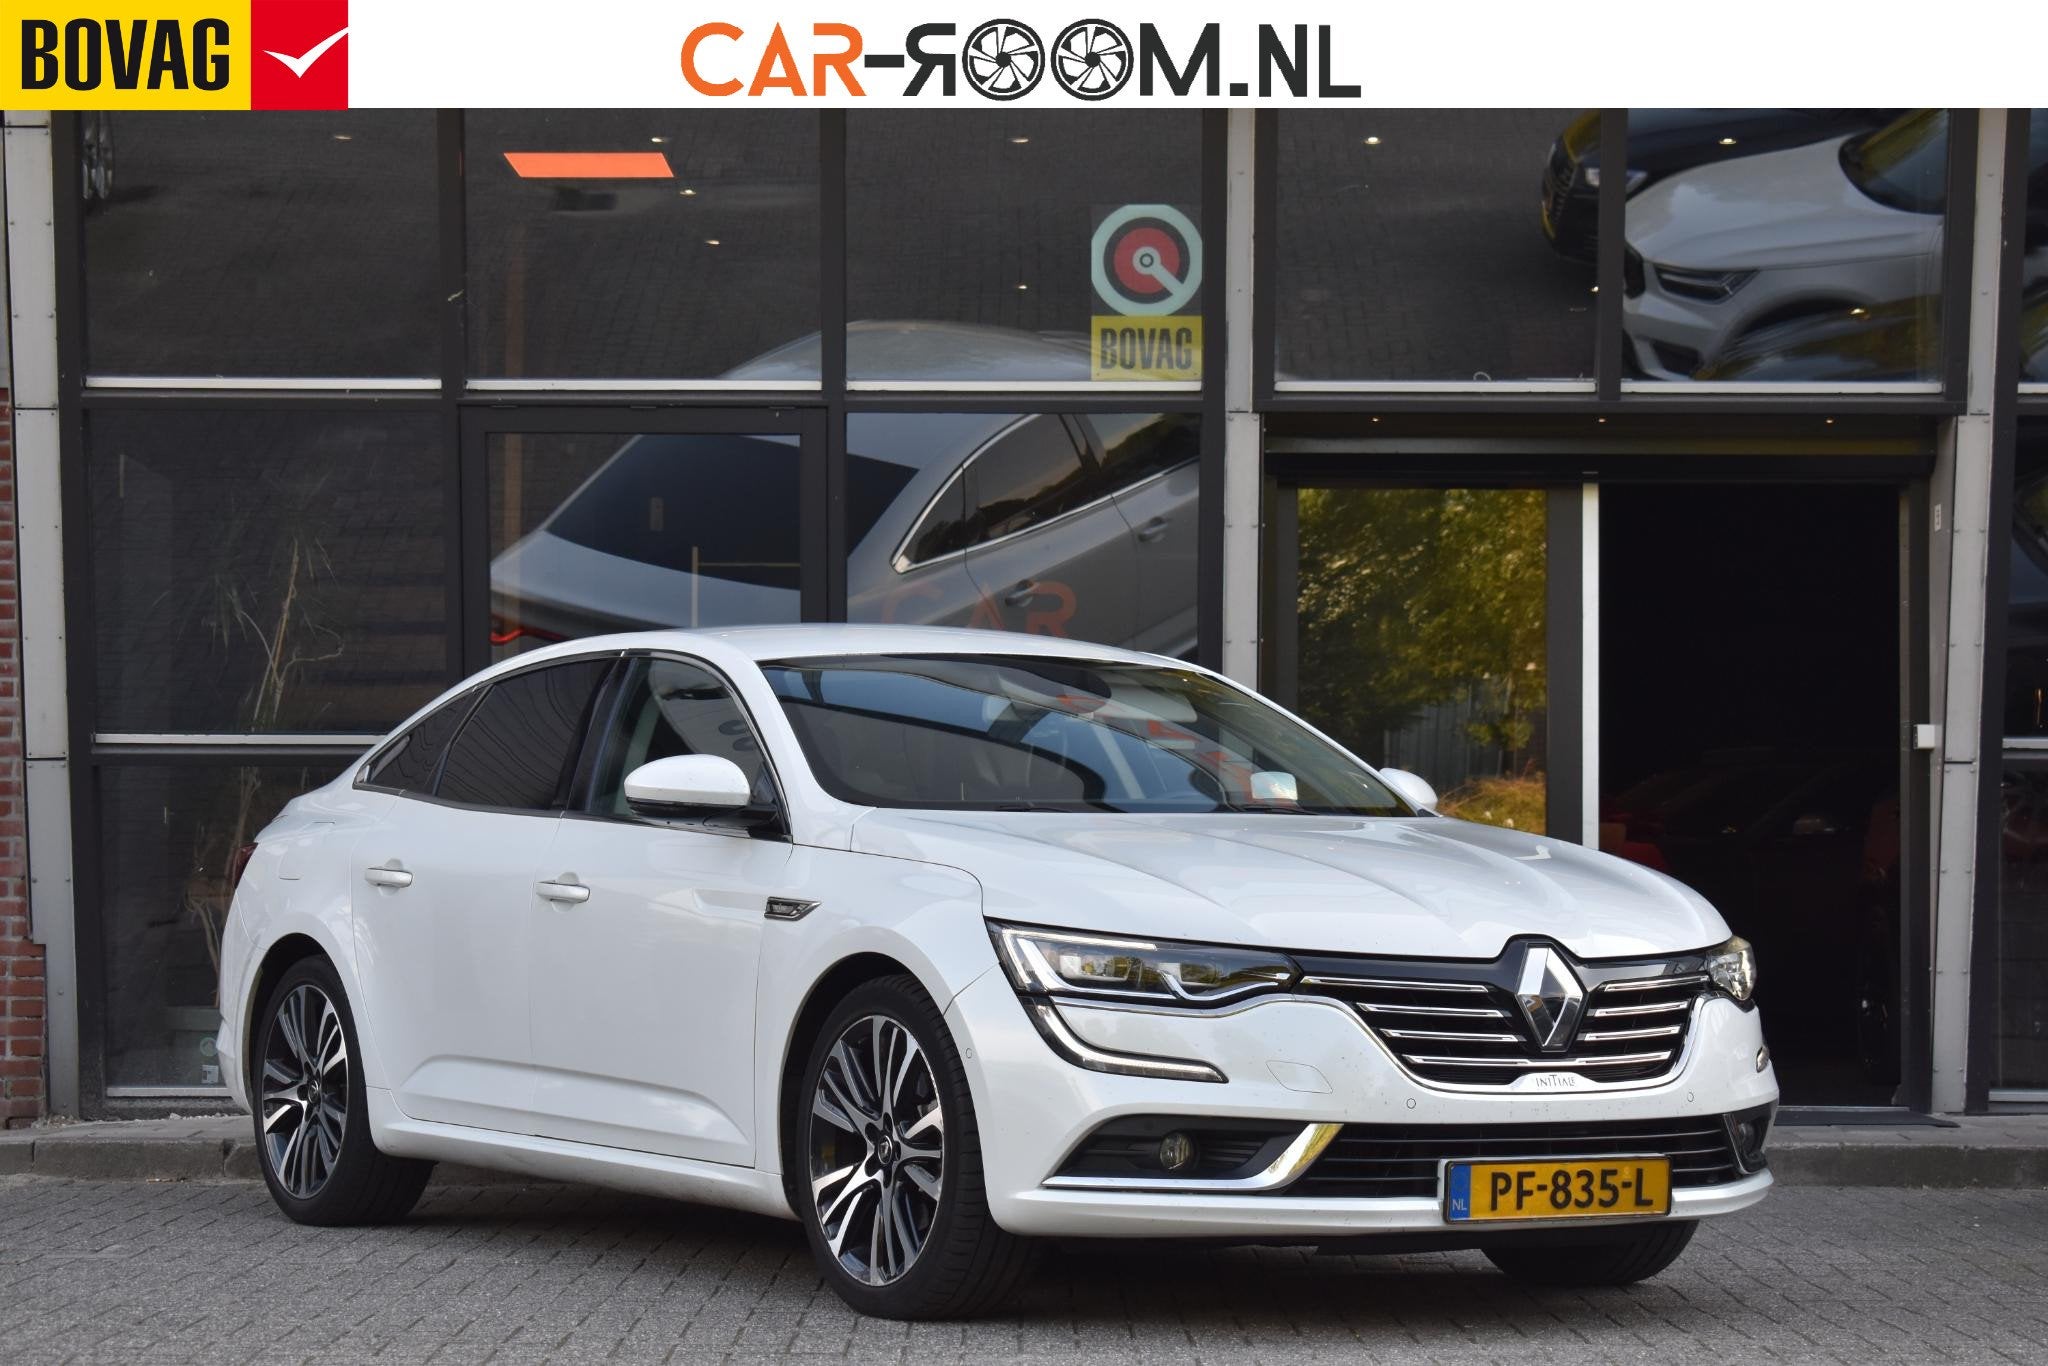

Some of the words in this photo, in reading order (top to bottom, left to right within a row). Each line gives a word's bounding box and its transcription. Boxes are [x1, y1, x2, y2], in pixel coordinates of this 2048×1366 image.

[1100, 327, 1192, 370] BOVAG
[1536, 1074, 1576, 1087] INITIALE
[1452, 1200, 1468, 1212] NL
[1491, 1168, 1654, 1211] PF-835-L
